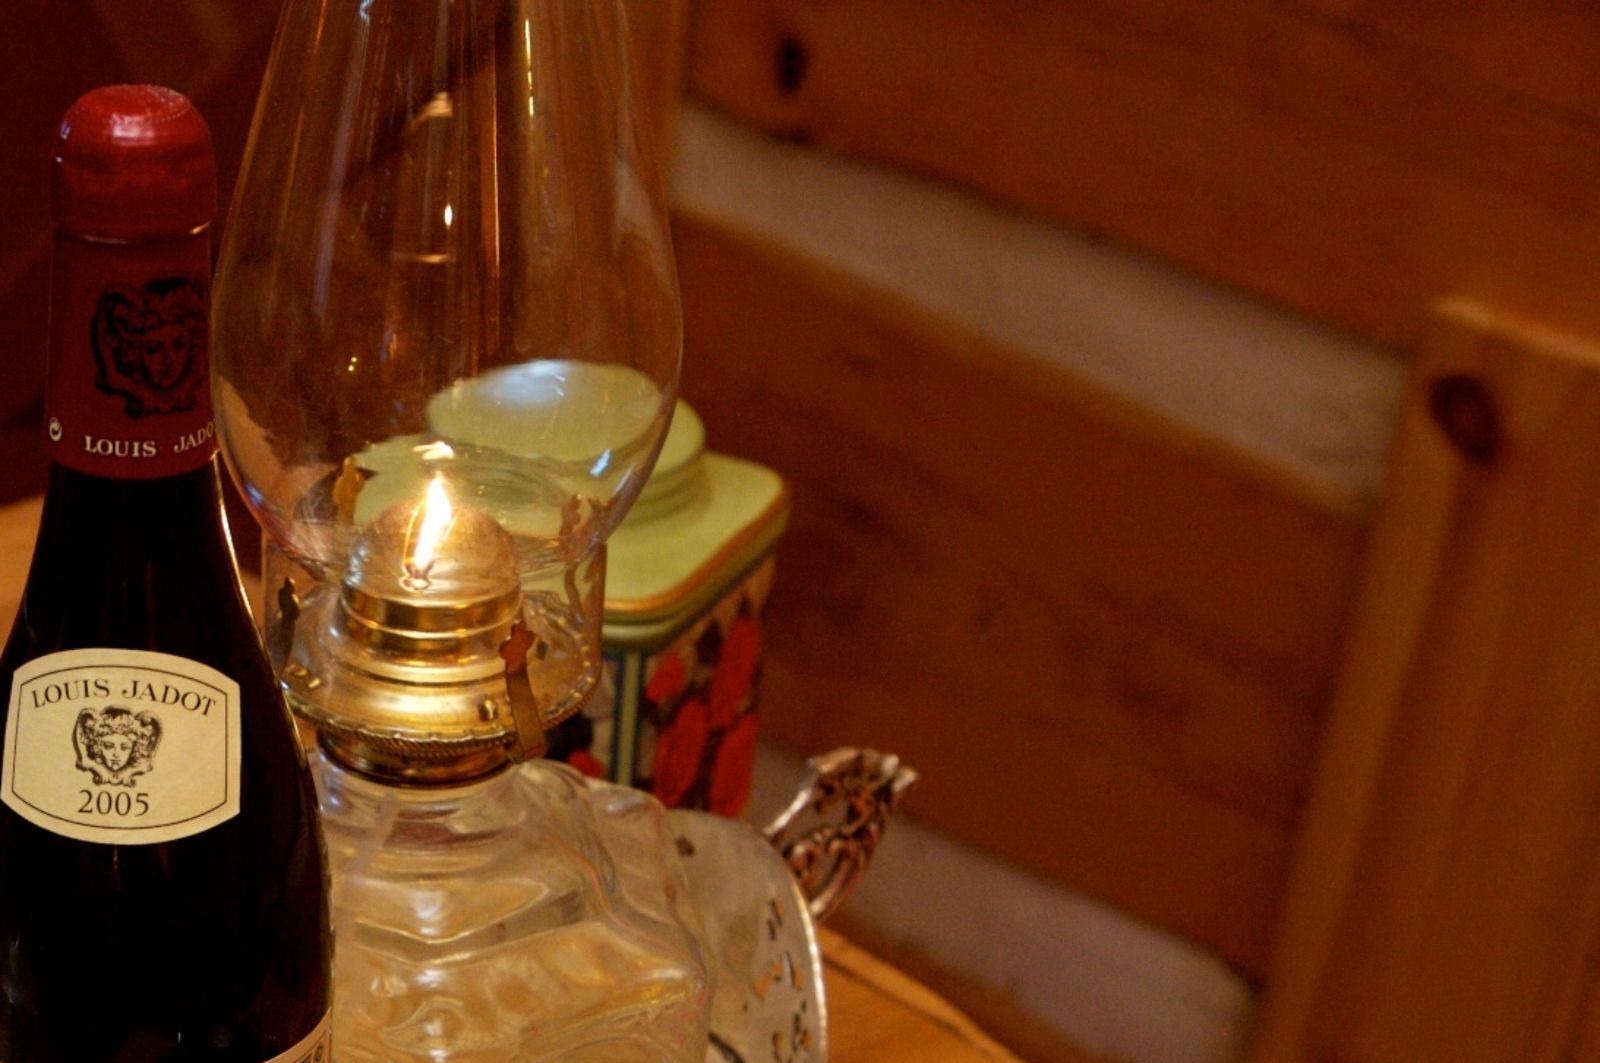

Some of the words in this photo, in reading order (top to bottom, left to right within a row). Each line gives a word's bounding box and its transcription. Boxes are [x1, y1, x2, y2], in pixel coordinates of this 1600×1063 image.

[84, 435, 157, 458] LOUIS
[32, 678, 111, 709] LOUIS
[121, 680, 217, 717] JADOT
[77, 788, 150, 817] 2005
